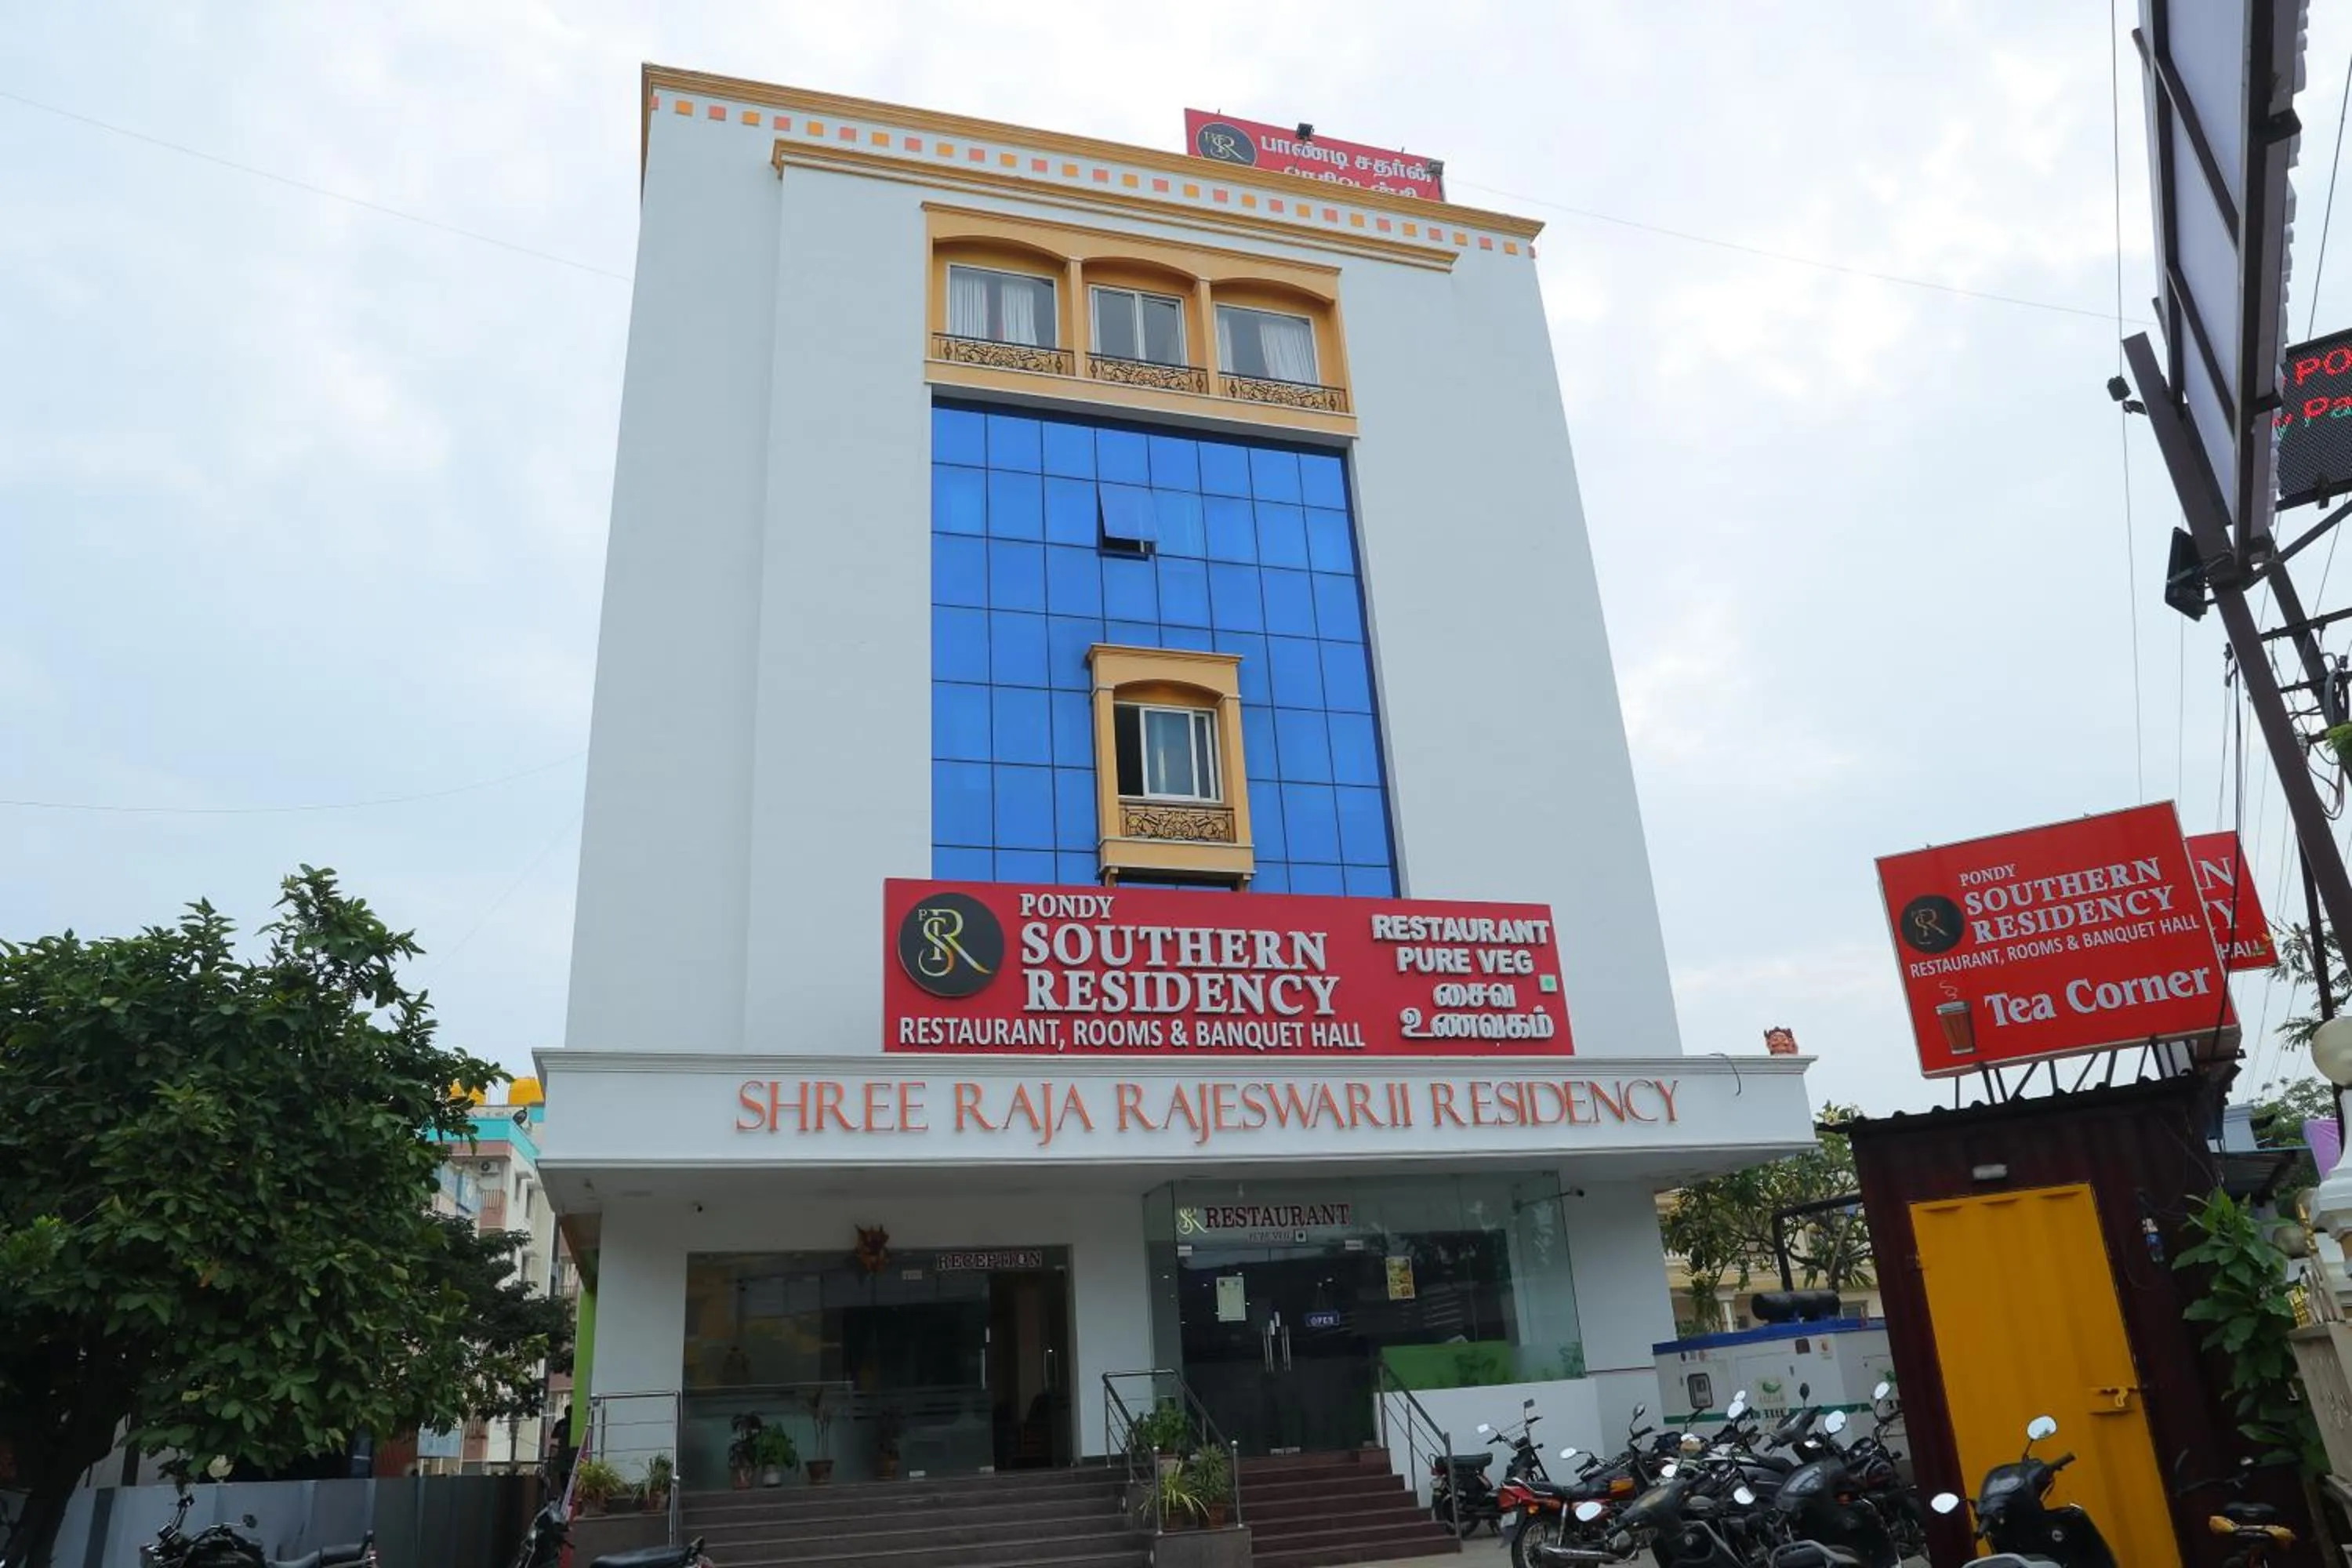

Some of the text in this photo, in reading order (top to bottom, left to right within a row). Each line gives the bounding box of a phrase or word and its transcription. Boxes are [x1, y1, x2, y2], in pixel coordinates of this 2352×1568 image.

[1260, 135, 1349, 170] பாண்டி
[1959, 864, 2017, 887] PONDY
[1964, 857, 2161, 916] SOUTHERN
[1020, 893, 1114, 919] PONDY
[1969, 886, 2175, 945] RESIDENCY
[1021, 922, 1327, 971] SOUTHERN
[1372, 914, 1550, 945] RESTAURANT
[1910, 914, 2200, 978] RESTAURANT, ROOMS & BANQUET HALL
[1396, 946, 1534, 975] PURE VEG
[1022, 969, 1340, 1016] RESIDENCY
[1433, 982, 1517, 1008] சைவ
[1984, 966, 2211, 1027] Tea Corner
[899, 1017, 1366, 1051] RESTAURANT, ROOMS & BANQUET HALL
[1399, 1005, 1555, 1039] உணவகம்
[736, 1078, 1679, 1145] SHREE RAJA RAJESWARII RESIDENCY
[1204, 1204, 1350, 1229] RESTAURANT
[936, 1251, 1042, 1269] RECEPTION
